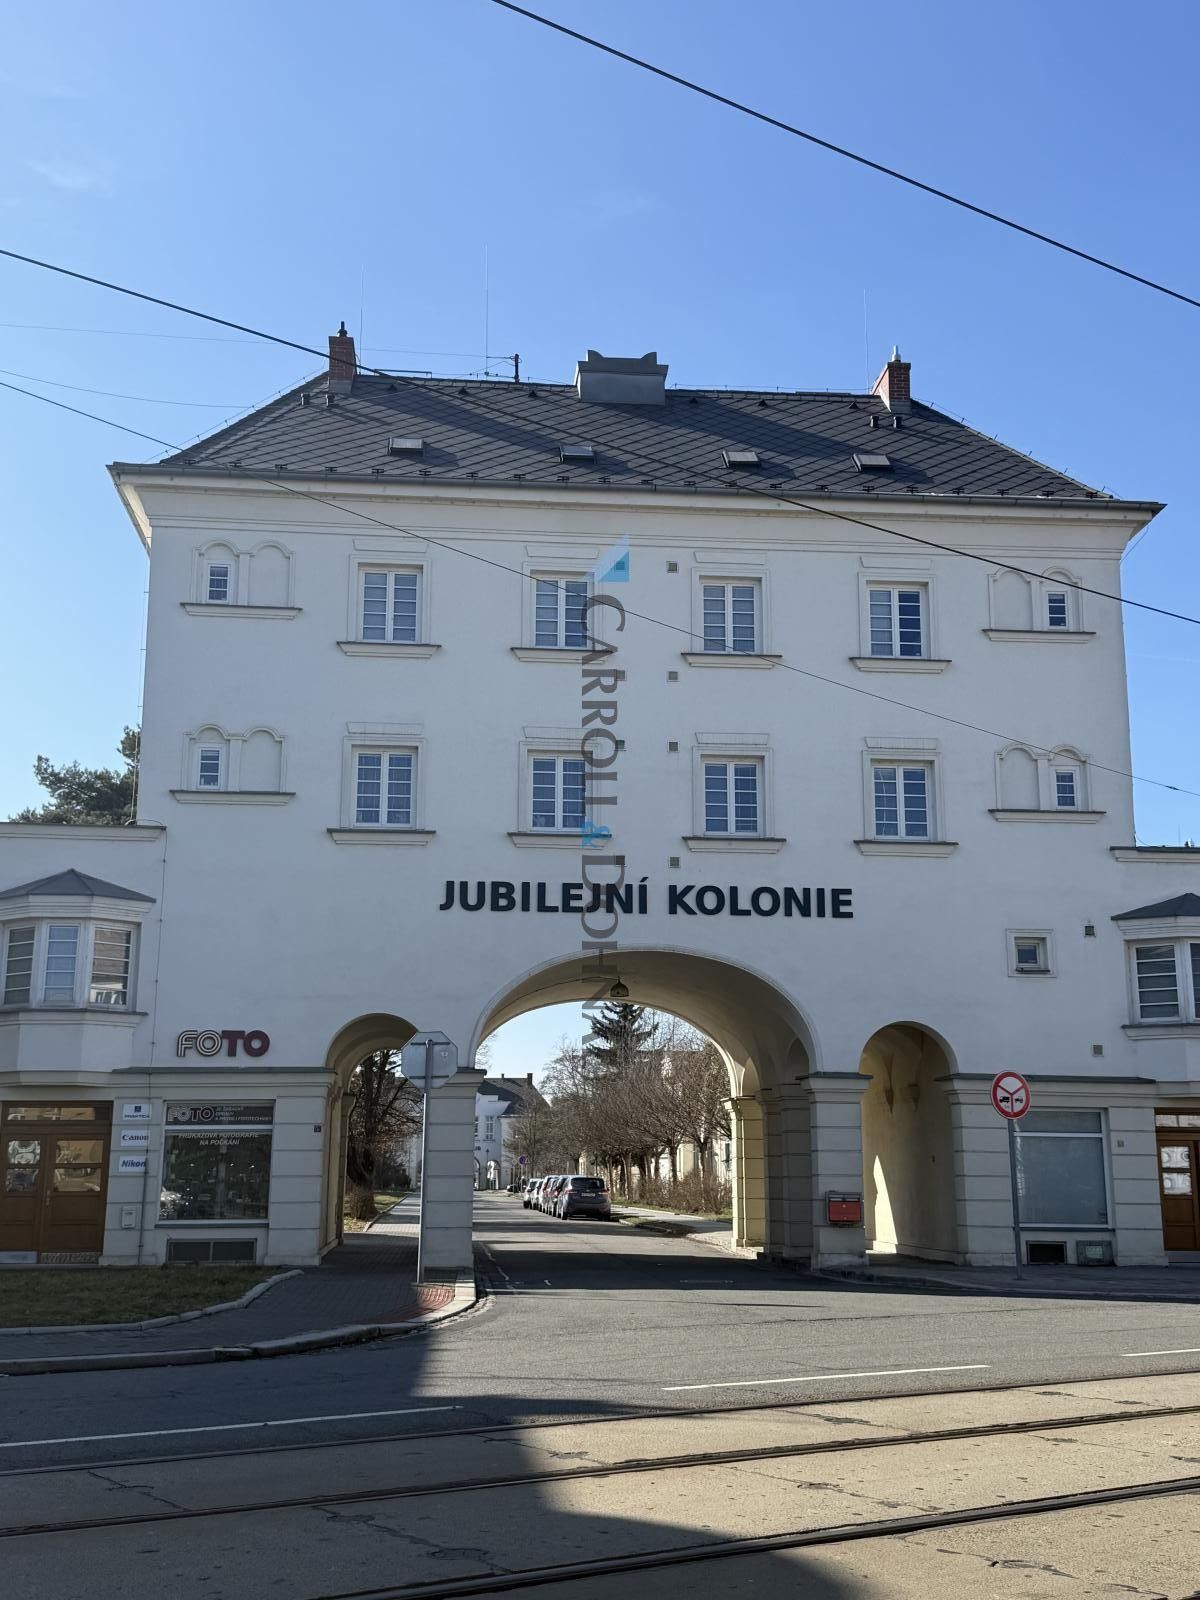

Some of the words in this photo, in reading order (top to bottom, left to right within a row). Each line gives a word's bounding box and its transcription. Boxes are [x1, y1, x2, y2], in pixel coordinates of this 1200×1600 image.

[439, 876, 649, 914] JUBILEJNÍ
[668, 884, 854, 919] KOLONIE
[176, 1029, 270, 1057] FOTO
[167, 1105, 215, 1122] FOTO
[121, 1159, 147, 1168] Nikon
